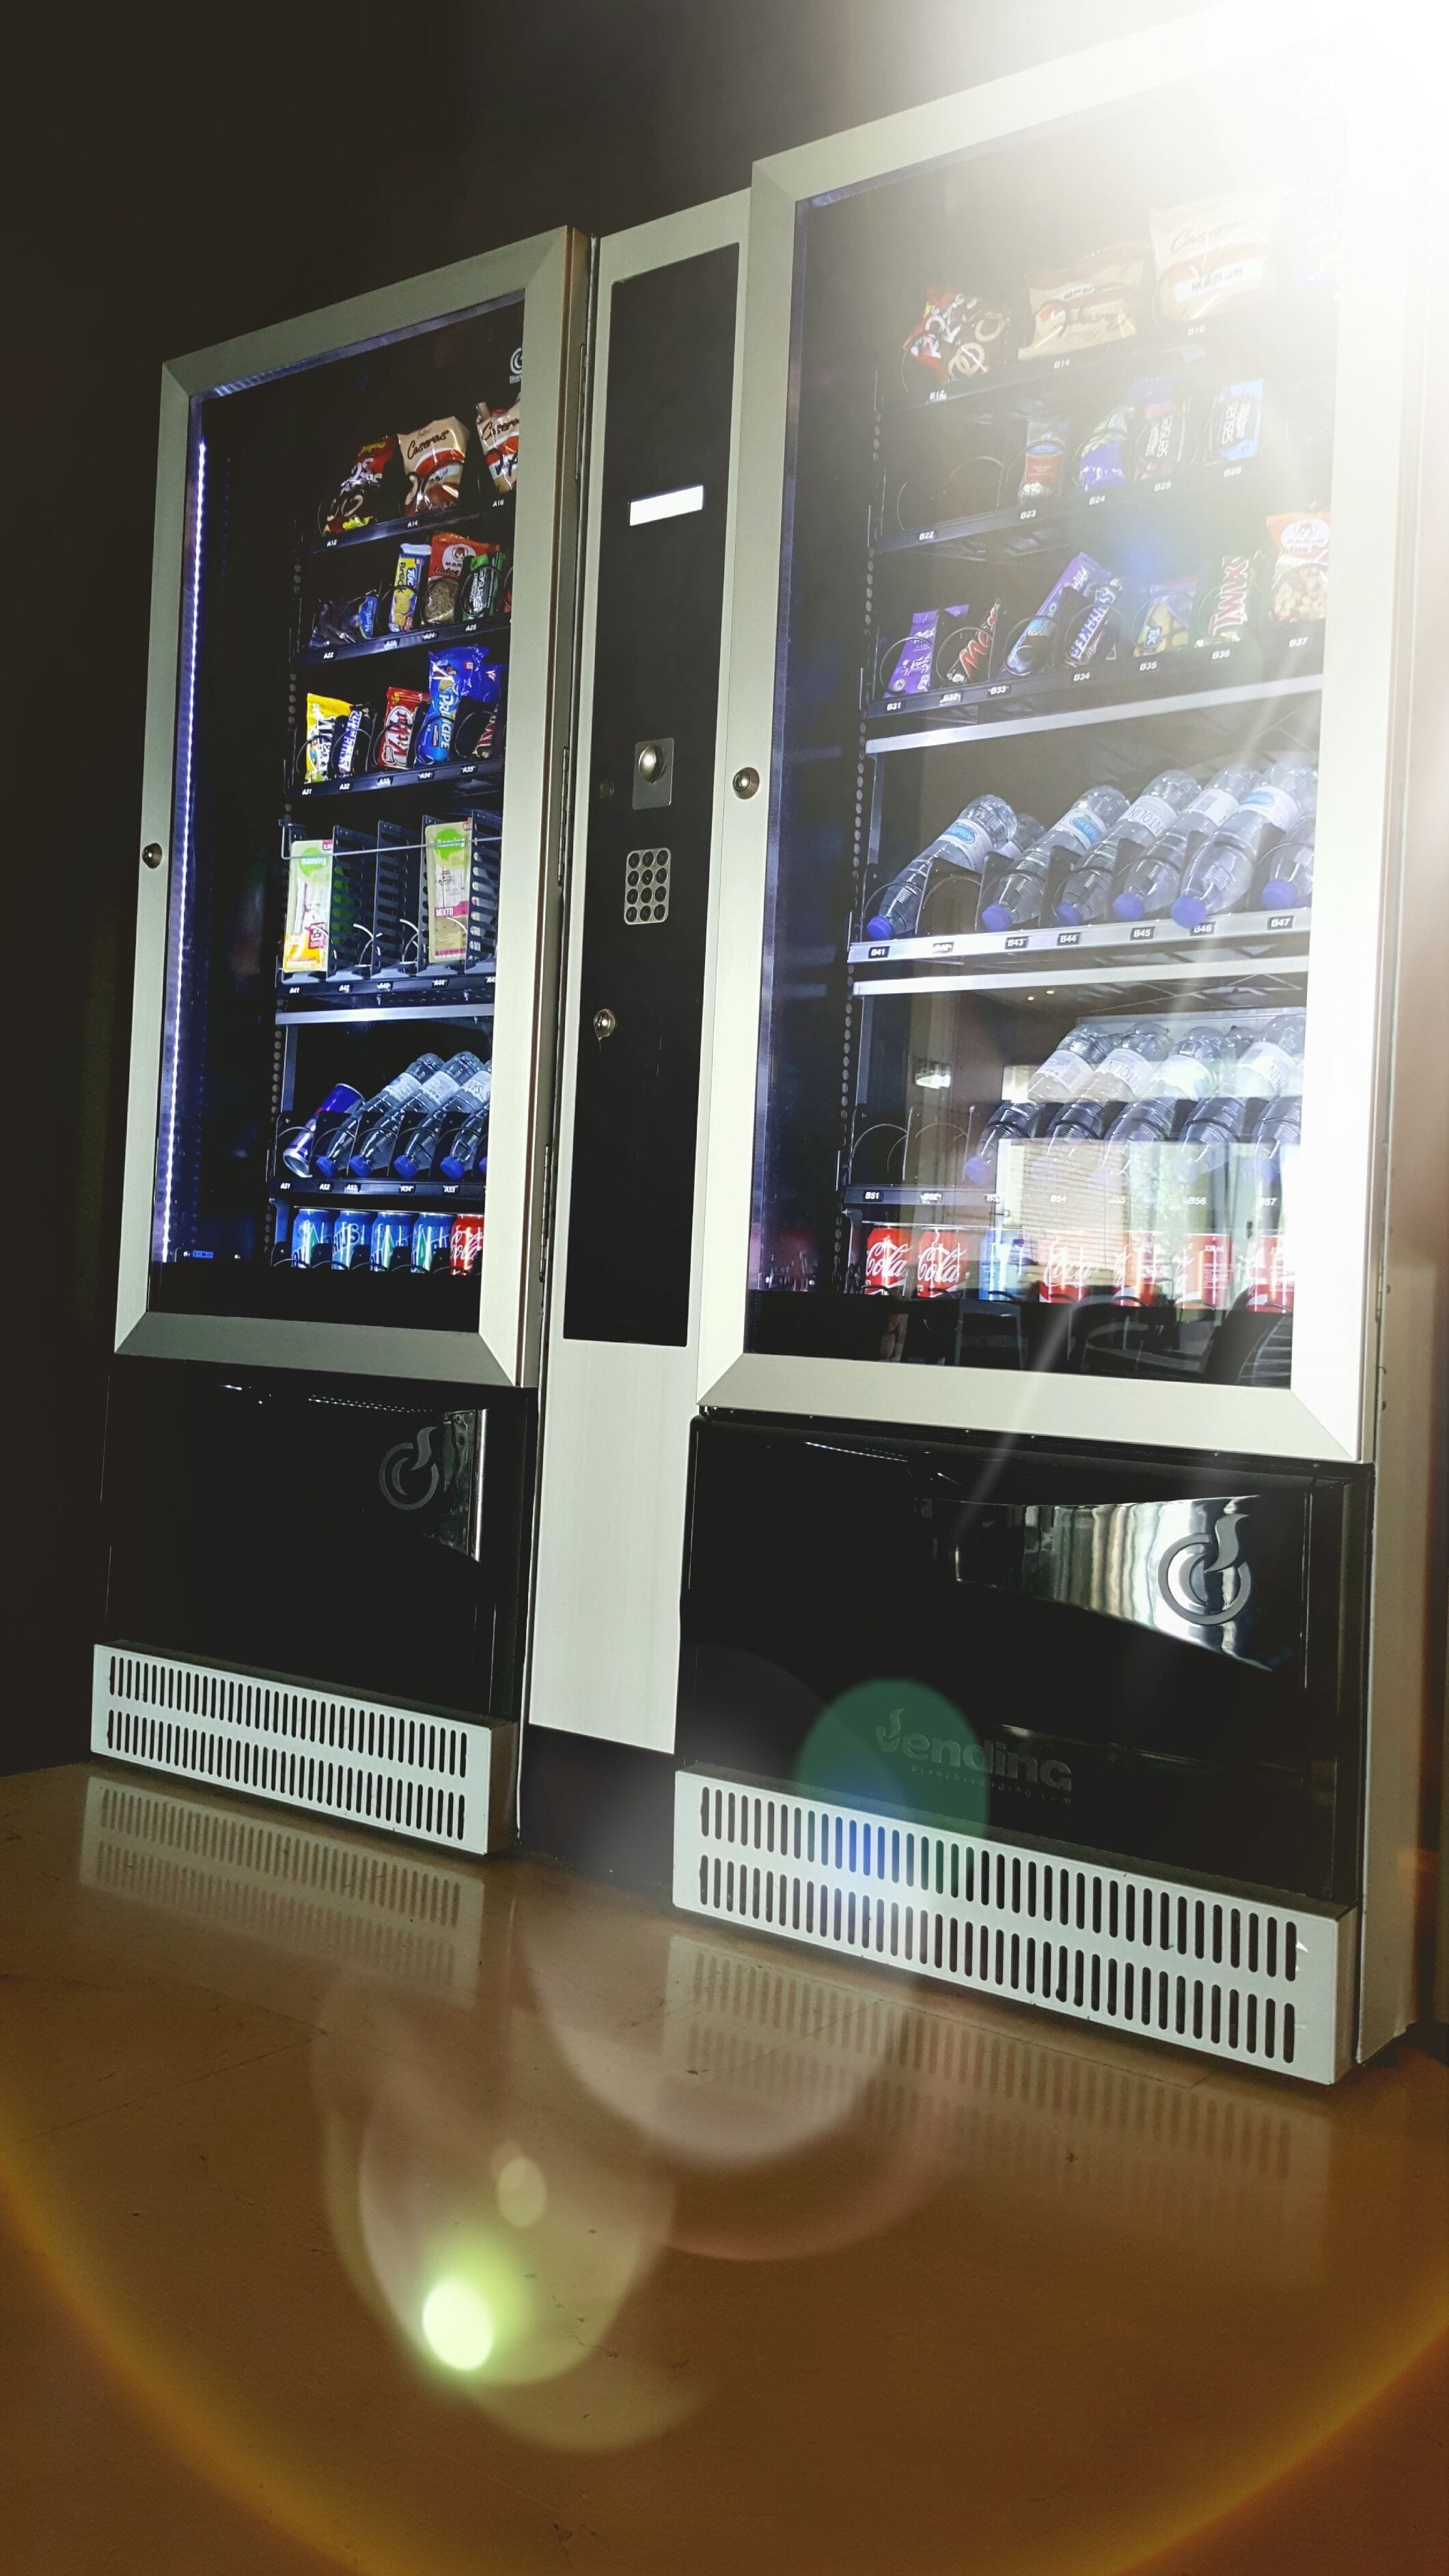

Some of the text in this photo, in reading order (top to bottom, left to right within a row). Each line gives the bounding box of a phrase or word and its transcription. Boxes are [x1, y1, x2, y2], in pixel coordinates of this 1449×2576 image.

[1053, 359, 1070, 369] B14
[1089, 495, 1105, 505] B24
[1020, 509, 1036, 519] B23
[407, 520, 418, 528] A14
[919, 531, 935, 541] B22
[327, 539, 338, 547] A12
[465, 624, 477, 632] A25
[1289, 637, 1309, 648] B37
[1212, 650, 1230, 660] B36
[1140, 662, 1157, 671] B35
[1073, 672, 1090, 681] B34
[991, 685, 1006, 695] B33
[887, 702, 901, 711] B31
[436, 907, 454, 917] MIXTO
[1271, 918, 1290, 928] B47
[1133, 929, 1150, 937] B45
[1193, 925, 1212, 933] B46
[1008, 939, 1023, 947] B43
[1060, 934, 1076, 943] B44
[1050, 1195, 1067, 1203] B54
[1188, 1197, 1206, 1205] B56
